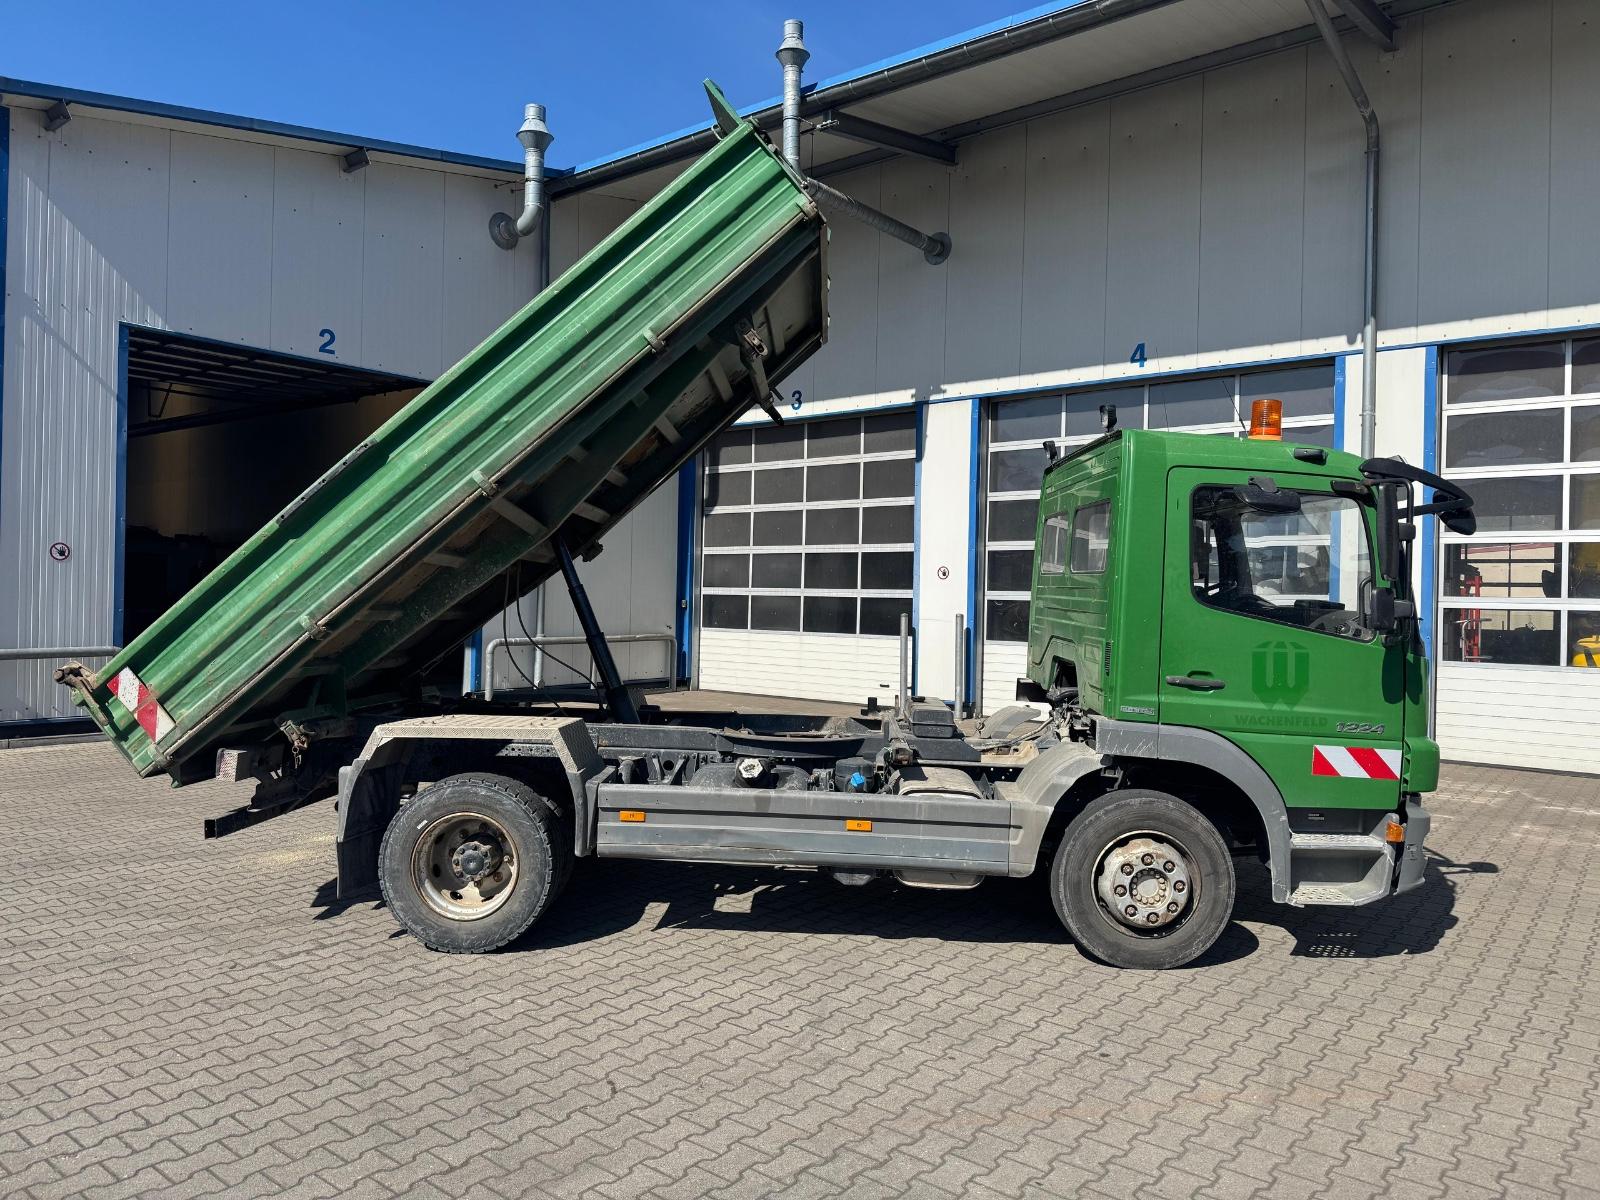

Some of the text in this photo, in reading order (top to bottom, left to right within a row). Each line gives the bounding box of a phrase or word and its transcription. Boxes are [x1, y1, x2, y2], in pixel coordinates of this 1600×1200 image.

[319, 329, 336, 354] 2
[1130, 342, 1147, 368] 4
[791, 389, 803, 411] 3
[1234, 714, 1328, 727] WACHENFELD
[1336, 721, 1385, 735] 1224
